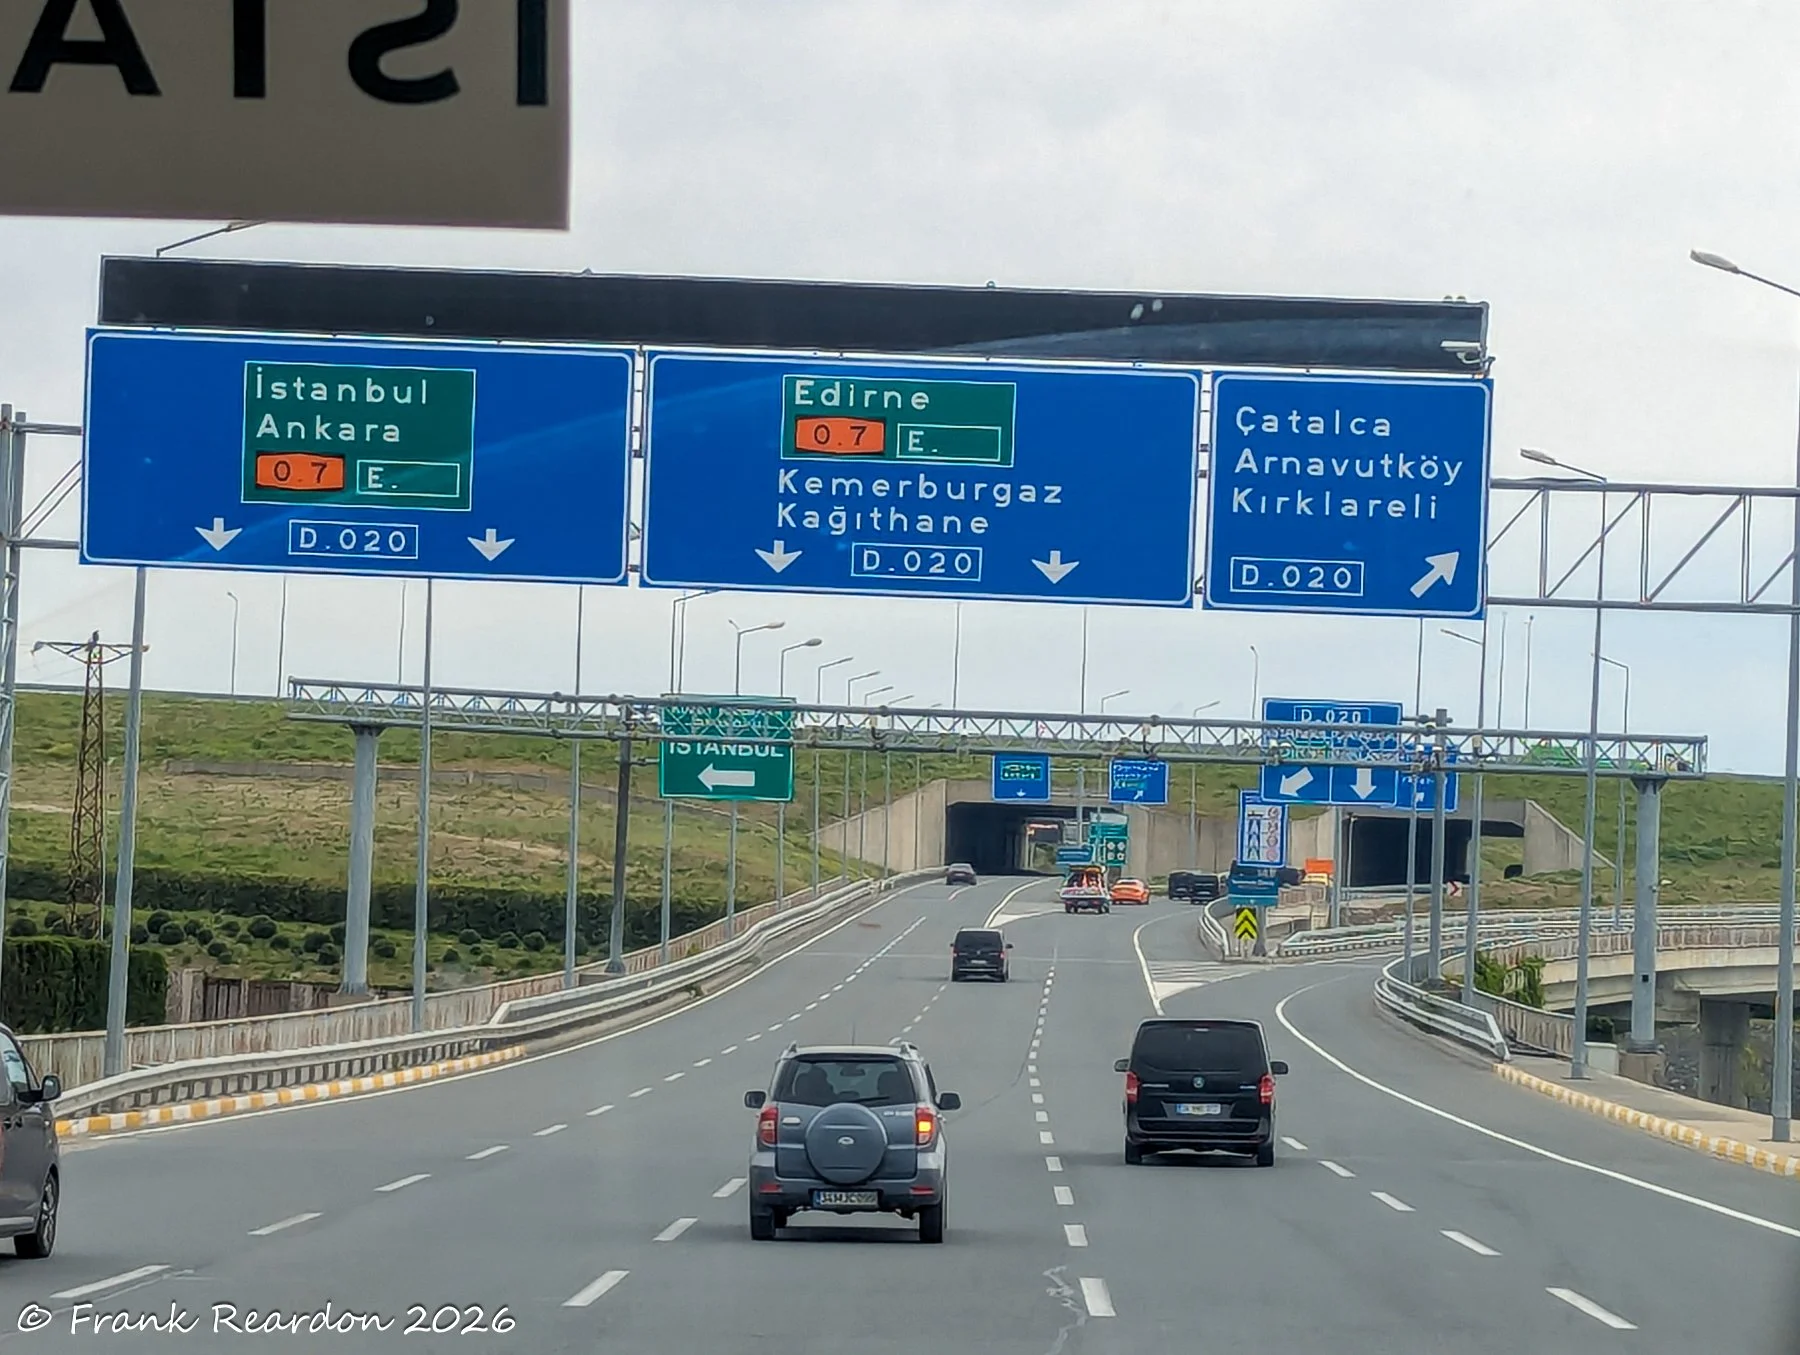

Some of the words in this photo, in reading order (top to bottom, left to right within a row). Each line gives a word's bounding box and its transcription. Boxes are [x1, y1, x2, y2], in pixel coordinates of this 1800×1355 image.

[256, 367, 429, 404] İstanbul
[795, 379, 930, 410] Edirne
[256, 413, 401, 442] Ankara
[1235, 406, 1390, 436] Çatalca
[1233, 448, 1462, 485] Arnavutköy
[778, 468, 1063, 507] Kemerburgaz
[1232, 487, 1436, 518] Kırklareli
[777, 503, 990, 536] Kağıthane
[299, 527, 406, 553] D.020
[862, 549, 973, 575] D.020
[1241, 564, 1352, 588] D.020
